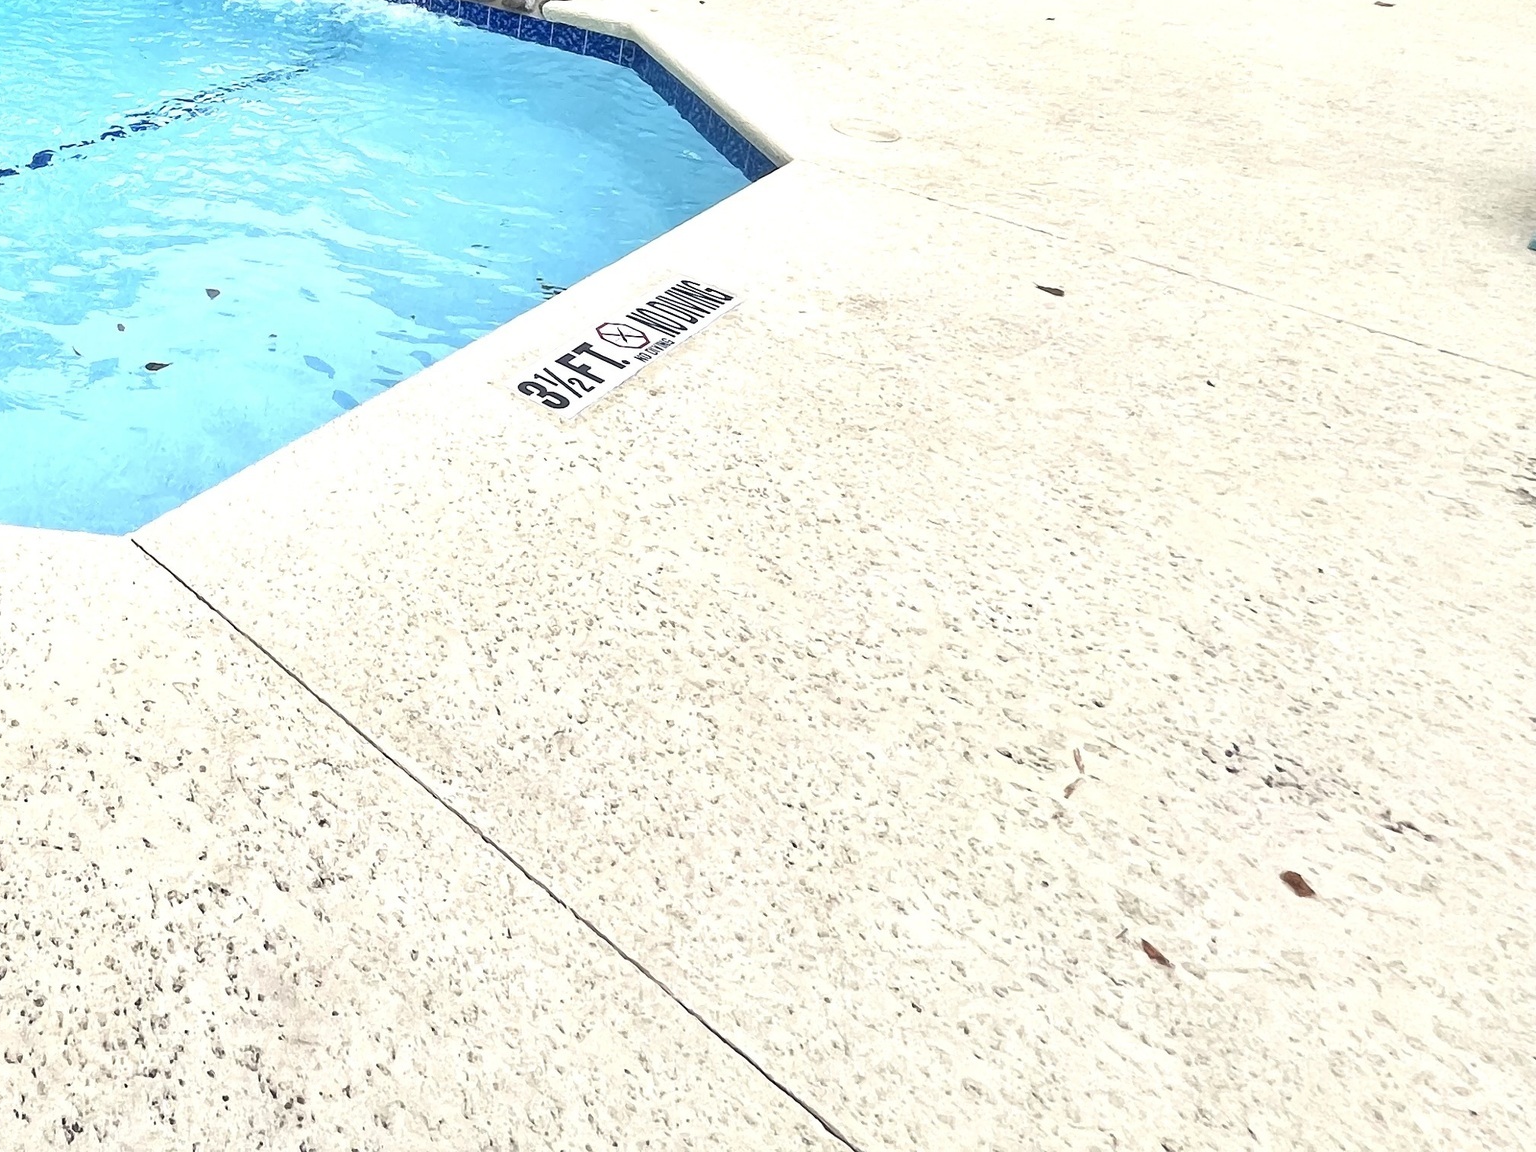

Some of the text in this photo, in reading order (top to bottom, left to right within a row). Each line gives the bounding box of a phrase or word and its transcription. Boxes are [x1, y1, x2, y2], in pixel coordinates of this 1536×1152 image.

[645, 279, 735, 325] DIVING
[625, 307, 688, 338] NO
[633, 337, 676, 363] NO DIVING
